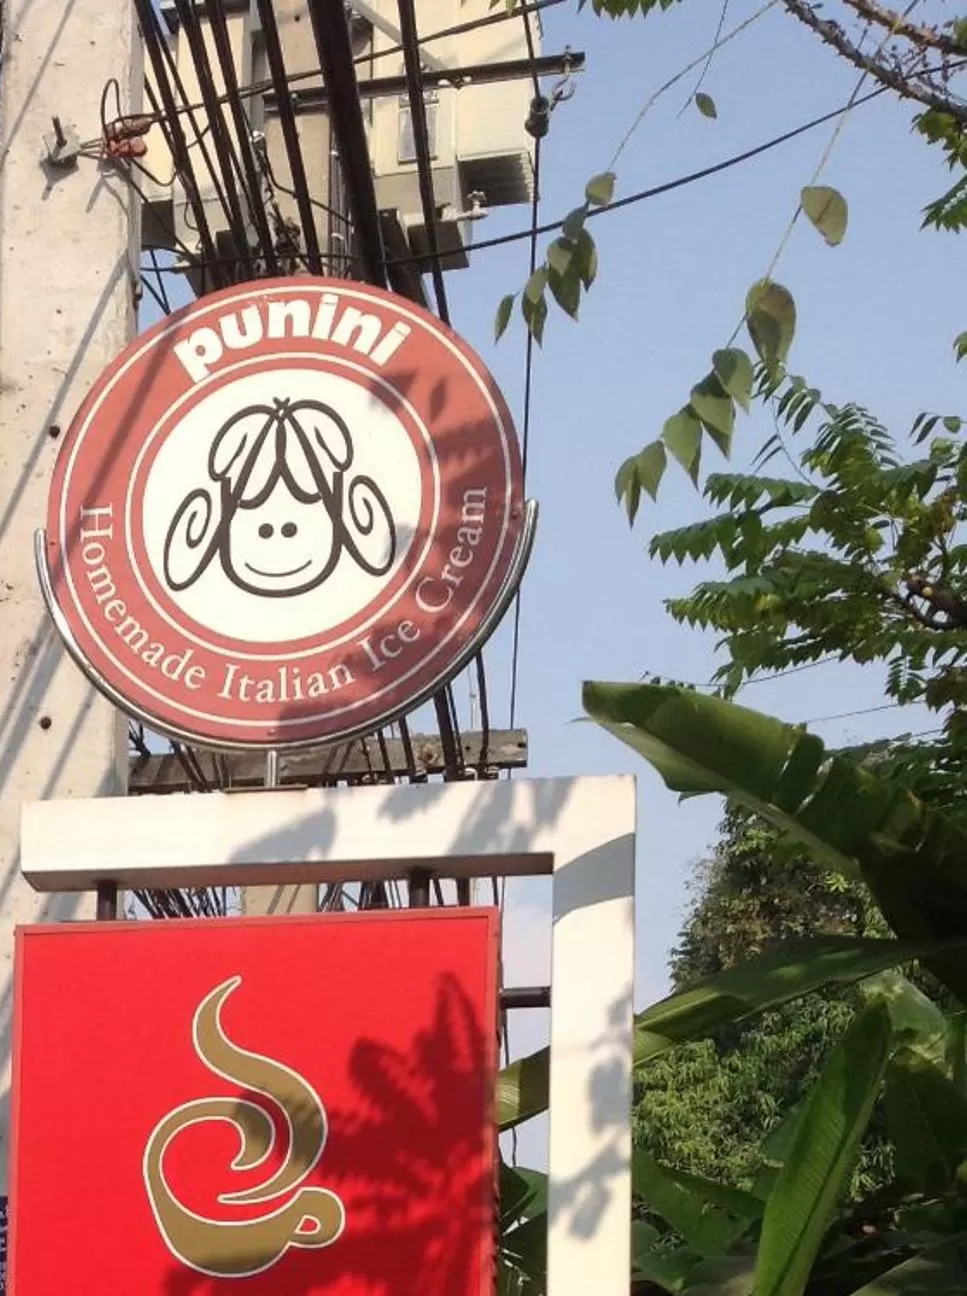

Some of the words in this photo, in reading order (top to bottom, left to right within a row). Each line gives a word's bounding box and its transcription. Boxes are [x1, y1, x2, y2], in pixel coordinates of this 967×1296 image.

[174, 293, 412, 383] punini
[80, 503, 207, 690] Homemade
[217, 662, 357, 704] Italian
[358, 620, 420, 672] Ice
[416, 486, 489, 615] Cream
